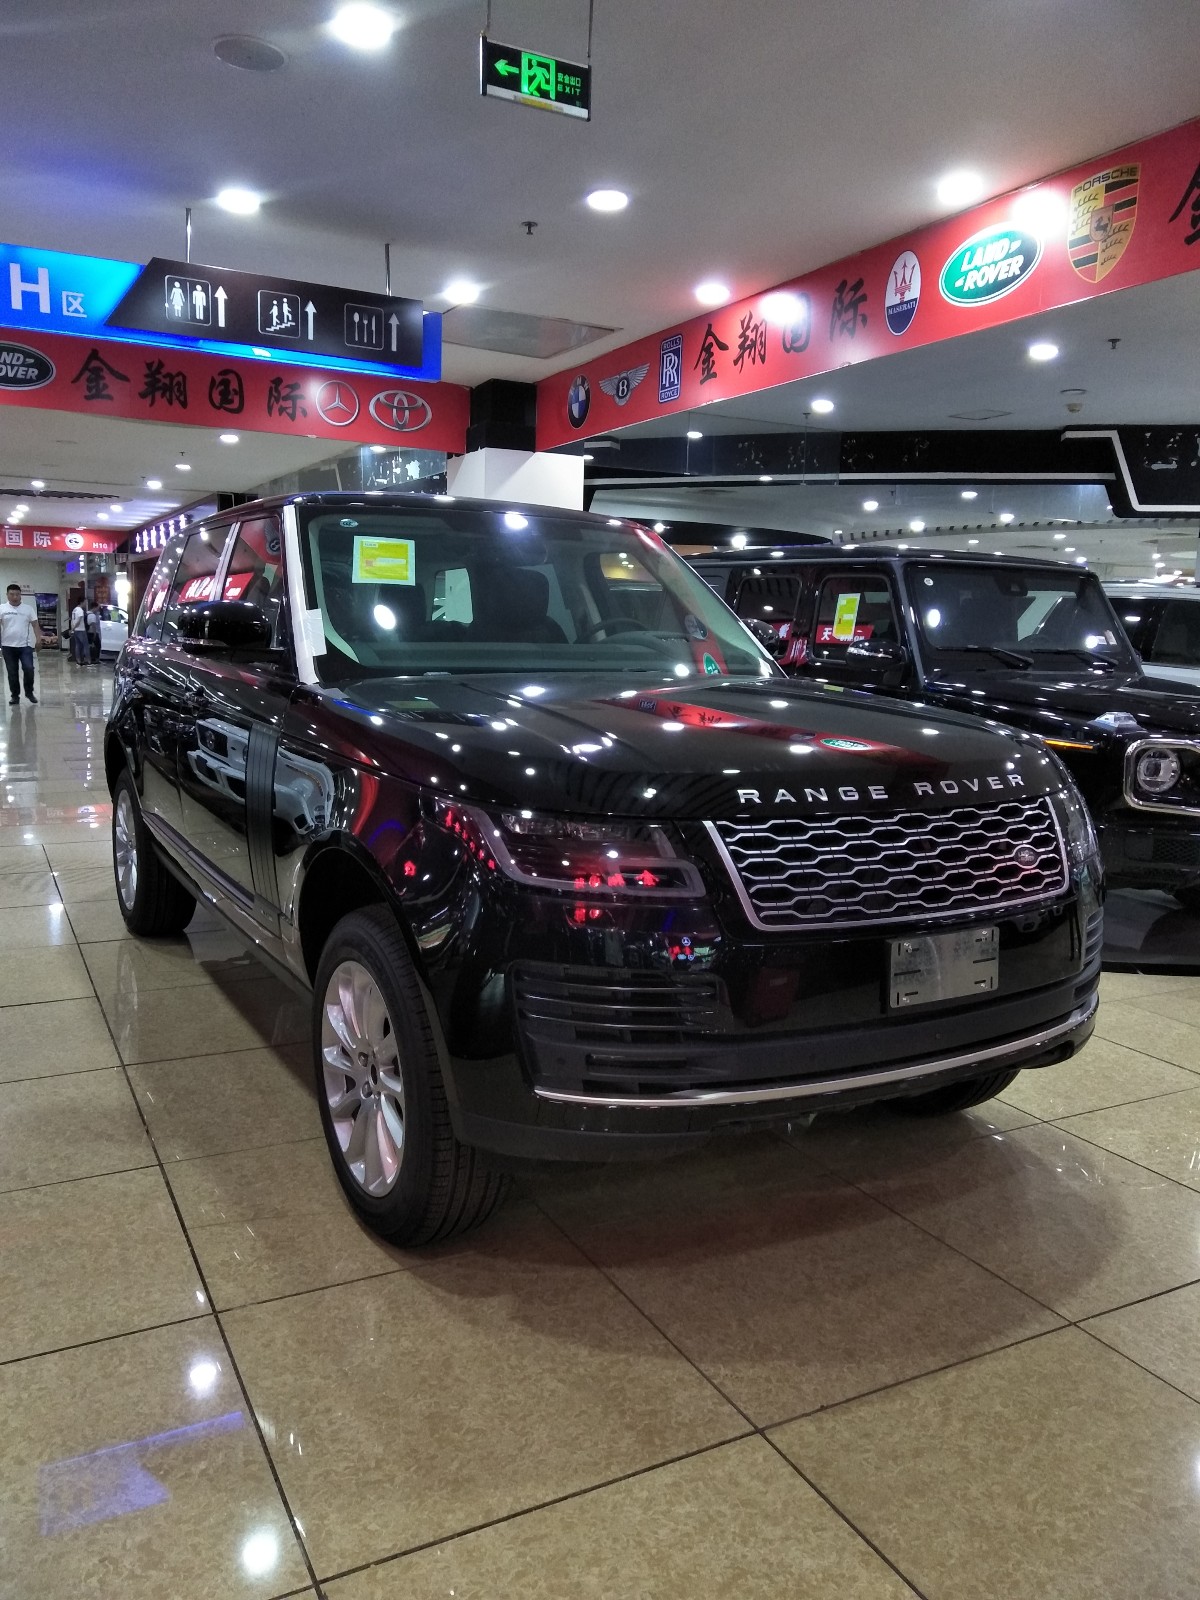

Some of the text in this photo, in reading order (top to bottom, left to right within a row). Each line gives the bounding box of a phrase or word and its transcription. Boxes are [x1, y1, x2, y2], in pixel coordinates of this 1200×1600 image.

[557, 83, 581, 95] EXIT
[1074, 166, 1138, 197] PORSCHE
[963, 255, 1024, 291] ROVER
[888, 300, 916, 315] MASERATI
[663, 339, 680, 350] ROLLS
[71, 348, 308, 422] 金翔国际
[660, 389, 678, 400] ROYCE
[736, 773, 1025, 804] RANGE ROVER
